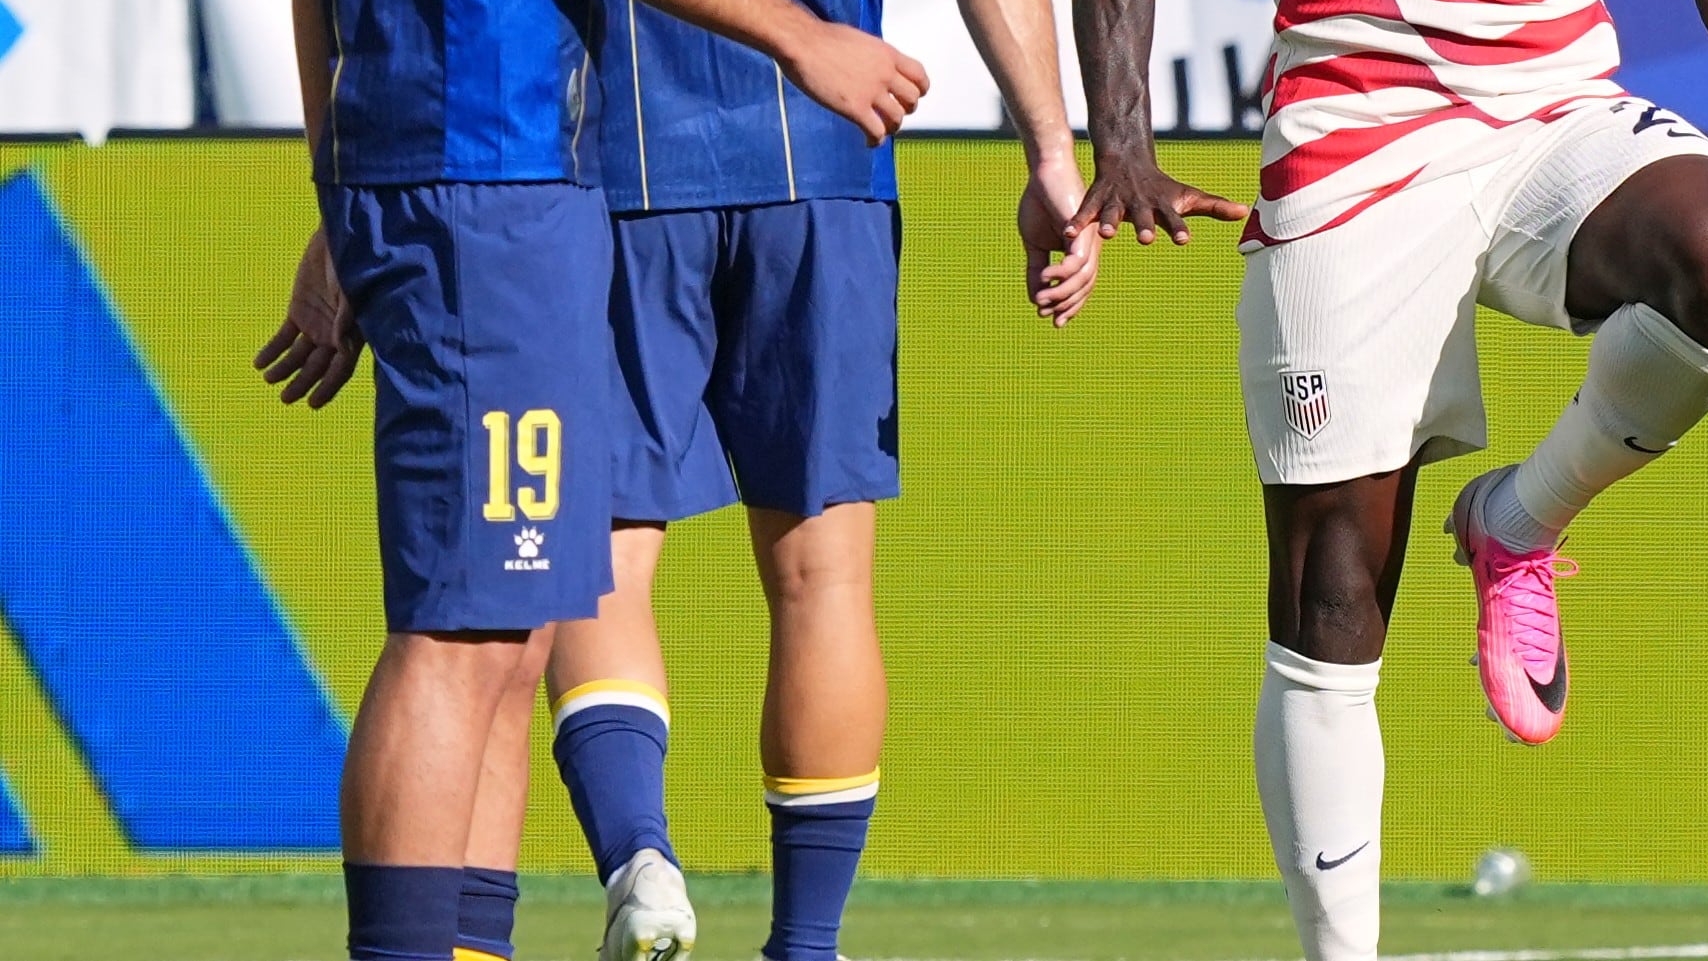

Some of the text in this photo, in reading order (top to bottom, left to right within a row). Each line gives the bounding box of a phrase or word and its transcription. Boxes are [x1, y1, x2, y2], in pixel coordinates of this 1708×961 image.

[1283, 374, 1323, 401] USA
[482, 409, 561, 521] 19
[504, 559, 550, 571] KELME
